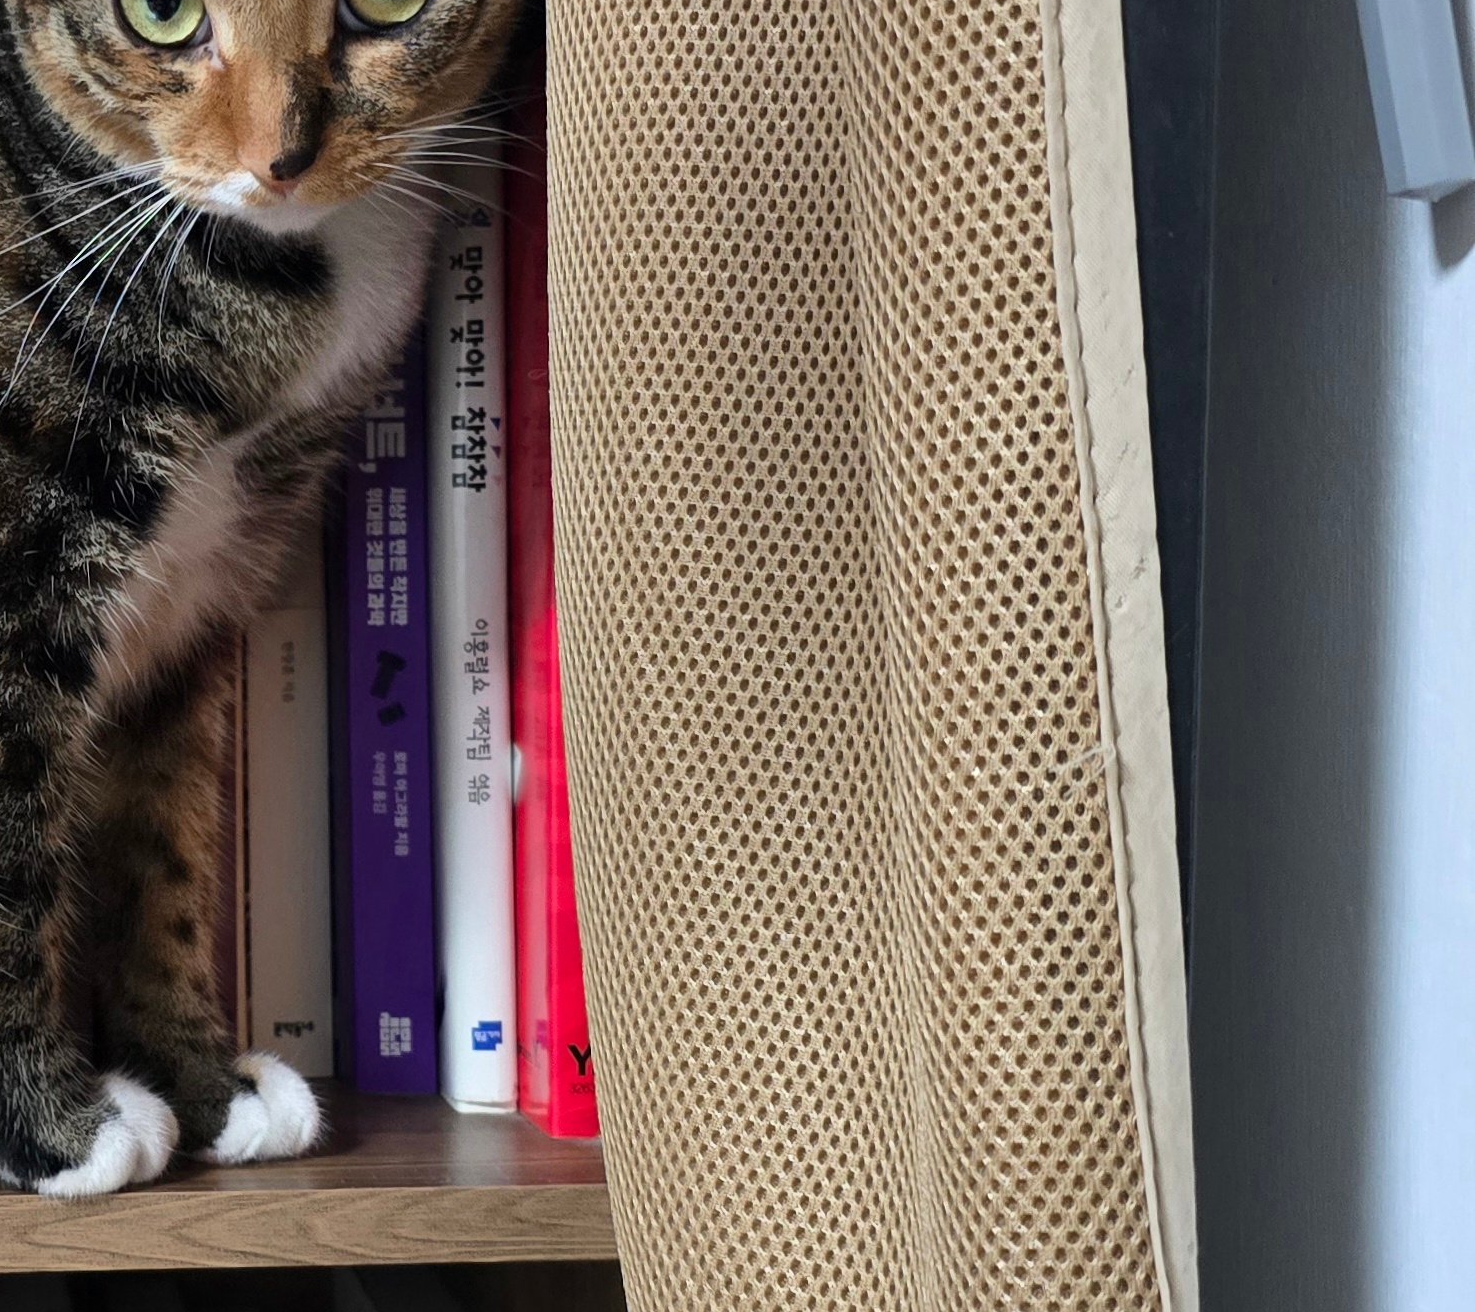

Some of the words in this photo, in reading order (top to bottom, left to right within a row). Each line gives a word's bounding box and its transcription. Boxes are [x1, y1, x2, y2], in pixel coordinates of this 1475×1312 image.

[448, 245, 485, 304] 맞아
[448, 319, 485, 389] 맞아!
[451, 406, 487, 493] 참참참
[463, 618, 490, 695] 이홍렬쇼
[465, 705, 492, 762] 제작팀
[467, 773, 491, 805] 엮음
